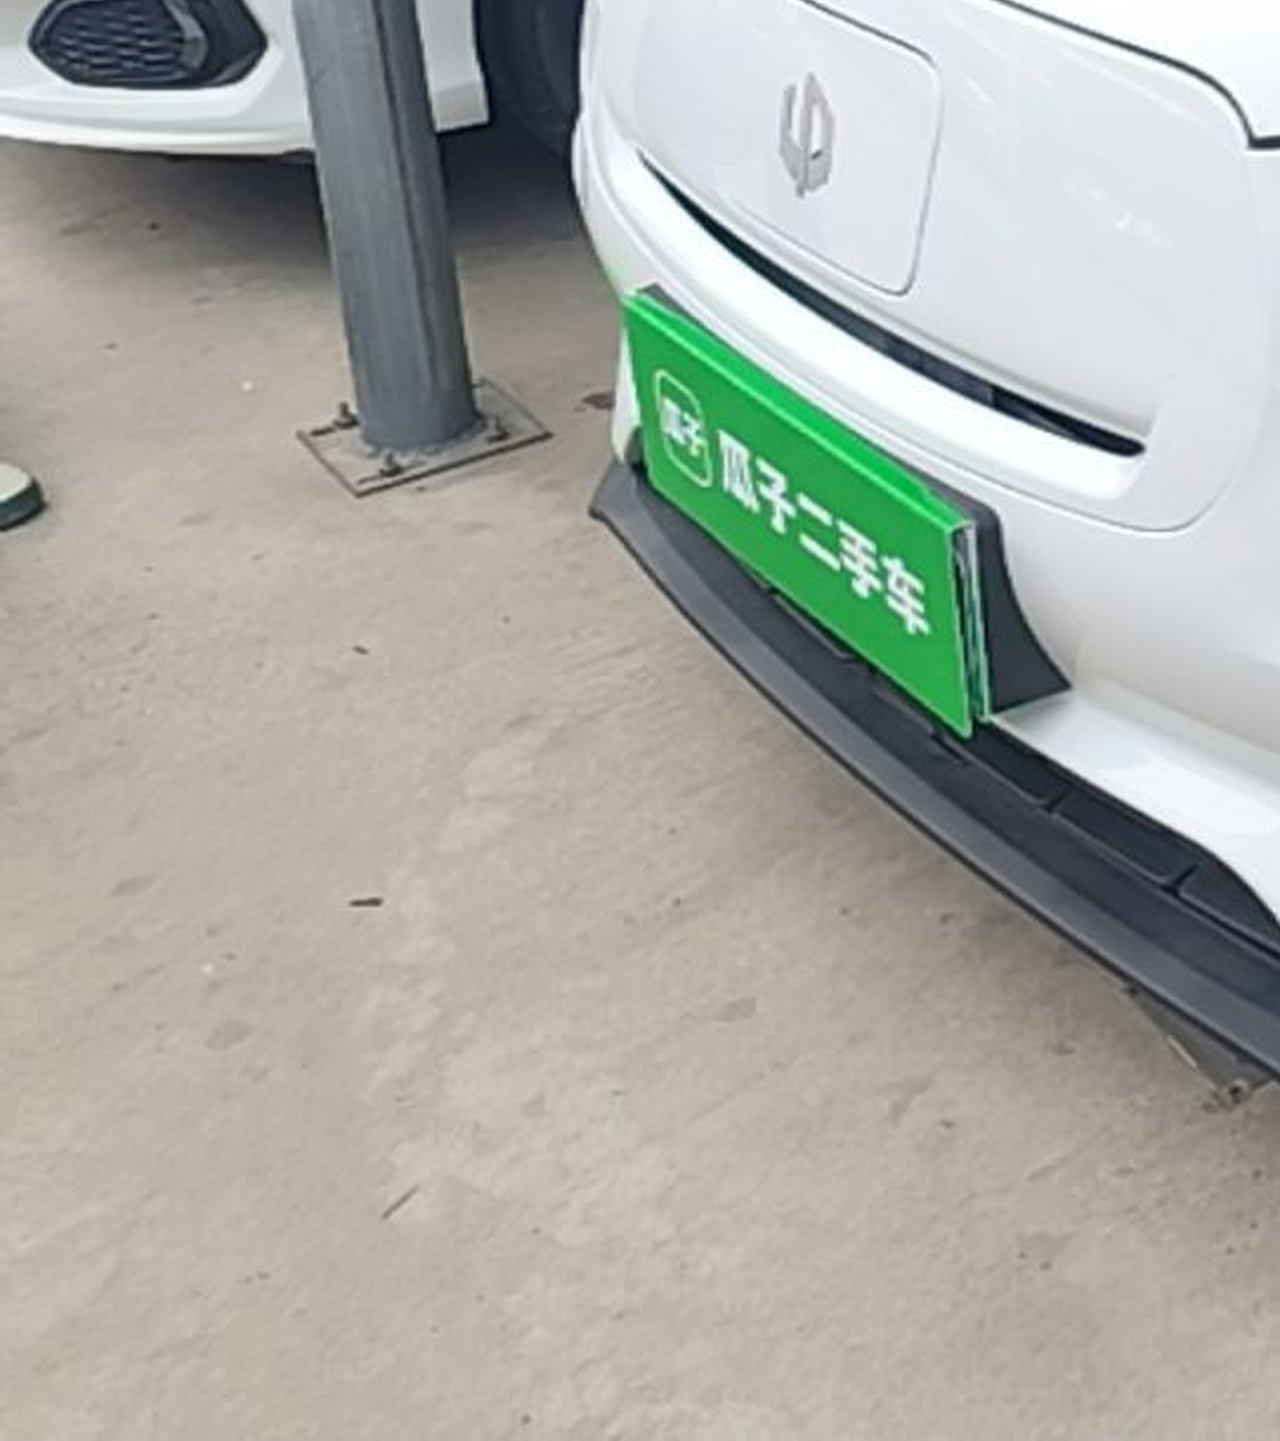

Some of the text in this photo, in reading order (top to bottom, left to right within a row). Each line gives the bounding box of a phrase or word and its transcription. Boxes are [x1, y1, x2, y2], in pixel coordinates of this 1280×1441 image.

[718, 428, 931, 636] 瓜子二手车
